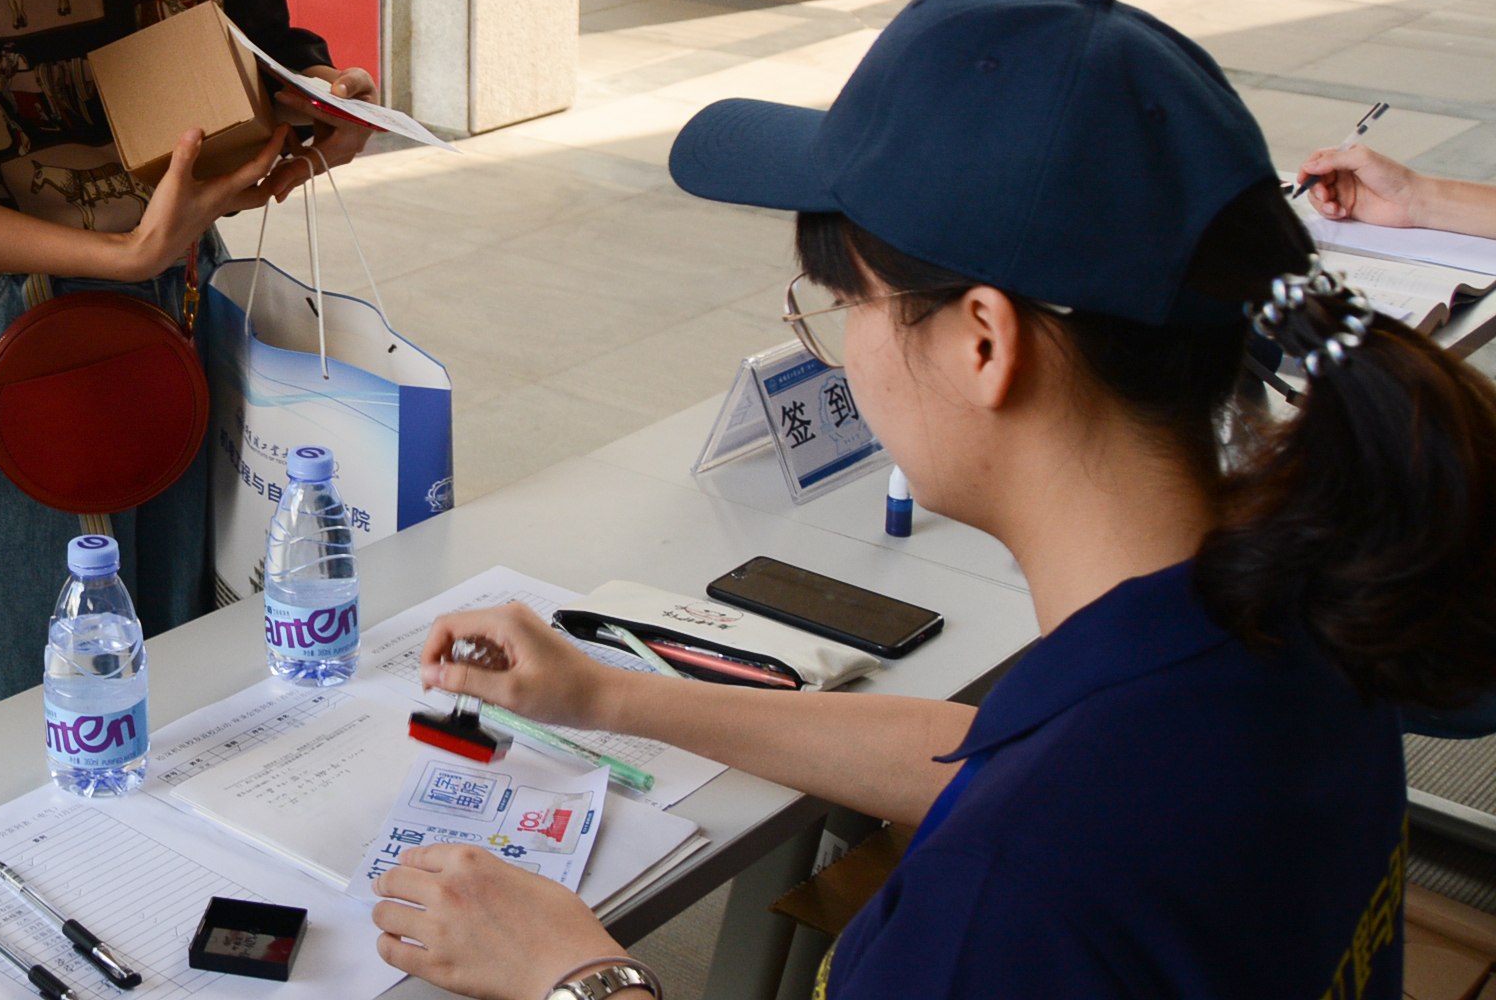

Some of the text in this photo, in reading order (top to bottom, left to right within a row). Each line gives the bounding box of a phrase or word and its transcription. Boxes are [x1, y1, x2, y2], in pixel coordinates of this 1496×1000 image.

[781, 377, 859, 449] 签到
[265, 604, 358, 649] anten
[45, 714, 136, 755] nten
